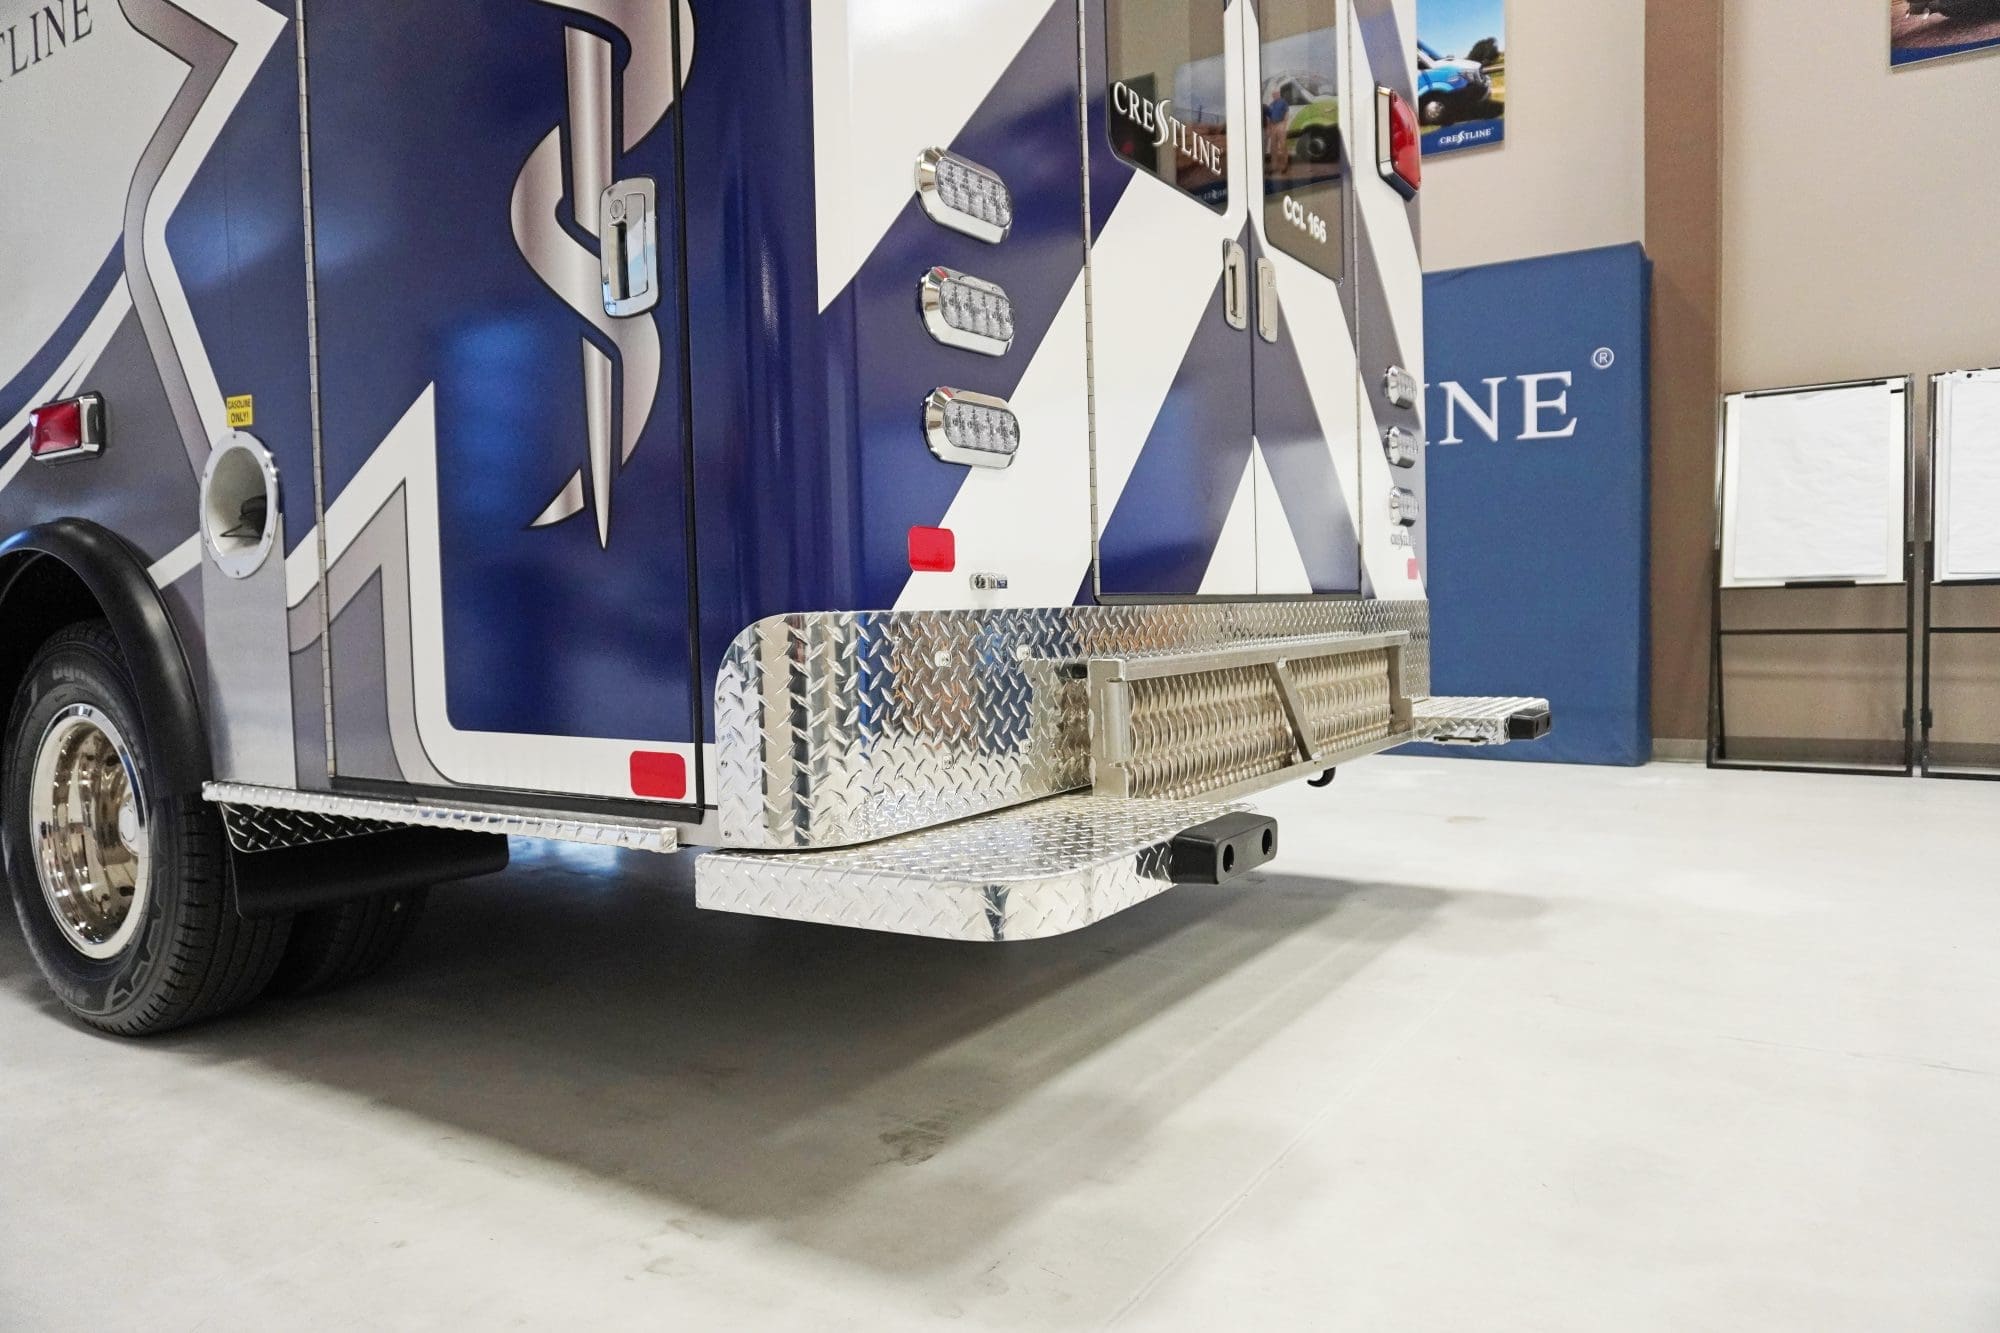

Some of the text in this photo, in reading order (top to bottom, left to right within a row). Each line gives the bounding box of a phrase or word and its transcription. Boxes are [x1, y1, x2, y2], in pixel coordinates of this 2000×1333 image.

[0, 0, 92, 83] LINE
[1114, 81, 1222, 176] CRESTLINE
[1439, 129, 1492, 144] CRESTLINE
[1283, 195, 1327, 243] CCL 166
[1425, 371, 1577, 446] NE
